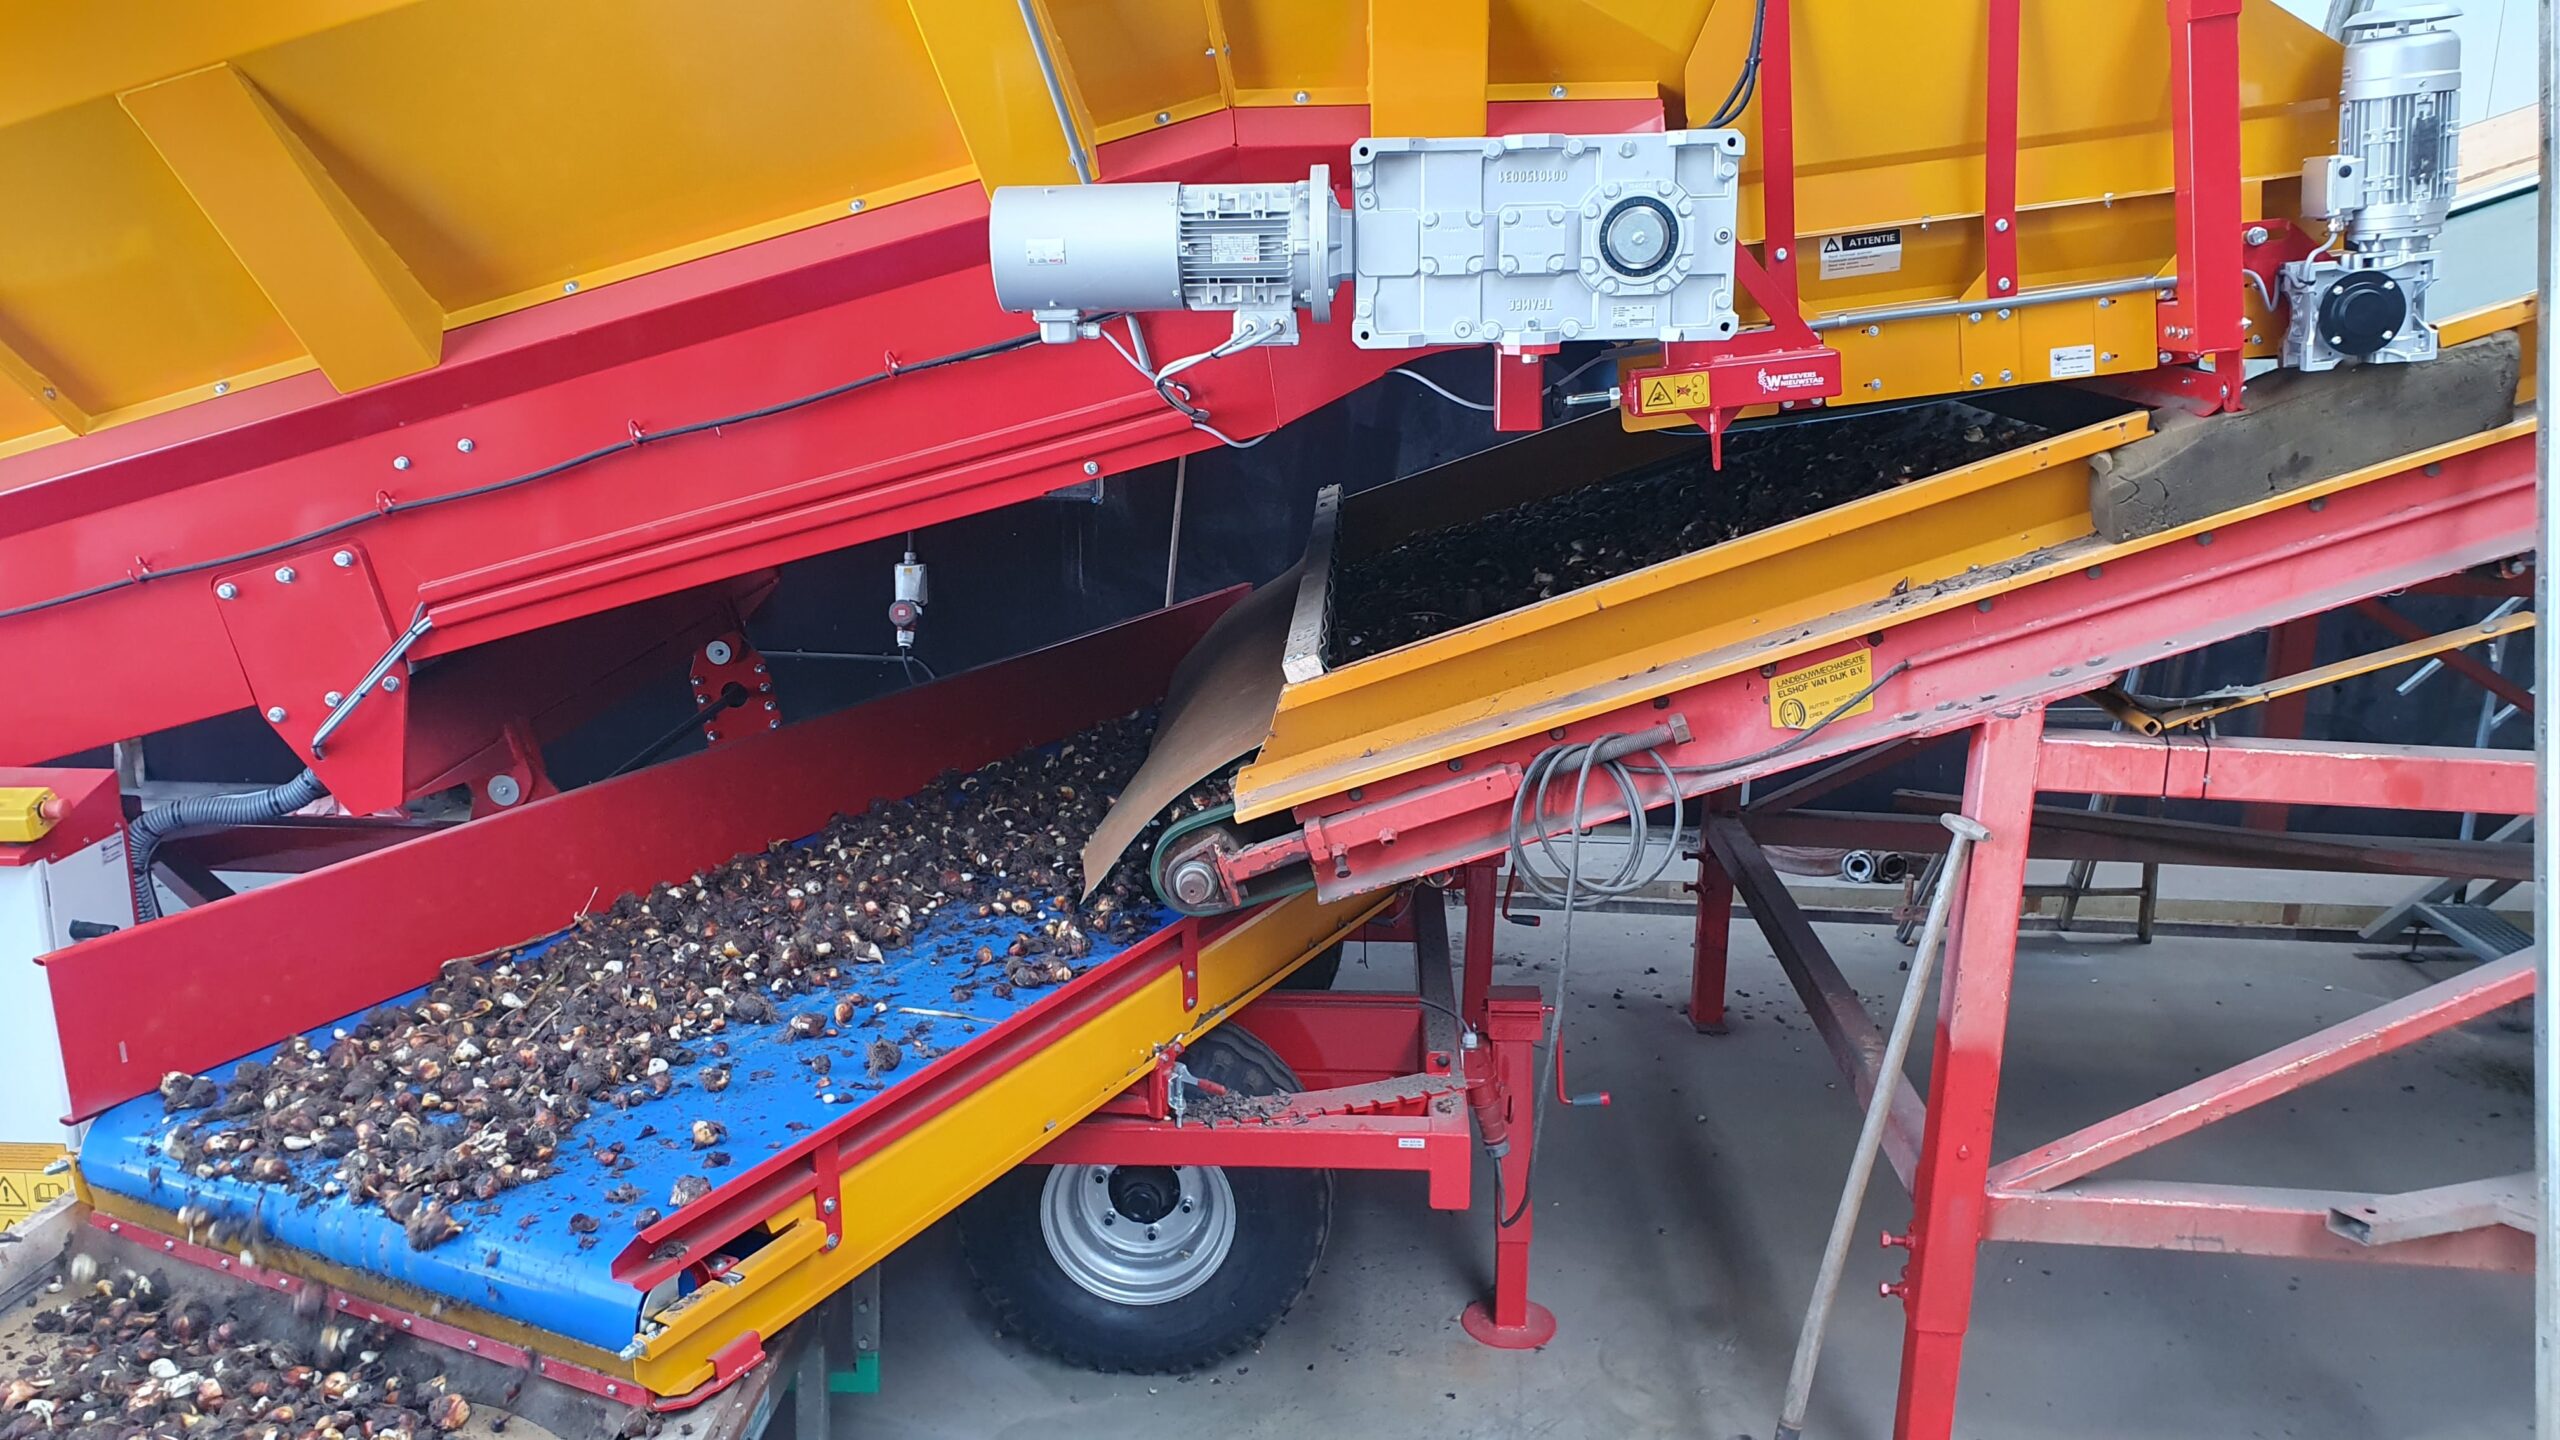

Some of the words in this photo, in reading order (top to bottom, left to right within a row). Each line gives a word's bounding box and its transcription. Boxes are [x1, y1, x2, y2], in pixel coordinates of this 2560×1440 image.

[1849, 233, 1896, 247] ATTENTIE
[1508, 298, 1553, 311] TRAMEC
[1780, 377, 1824, 386] NIEUWSTAD
[1782, 372, 1816, 380] WEEVERS
[1776, 654, 1866, 688] LANDBOUWMECHANISATIE
[1778, 683, 1809, 698] ELSHOF
[1811, 677, 1828, 688] VAN
[1830, 671, 1848, 682] DIJK
[1850, 666, 1865, 676] B.V.
